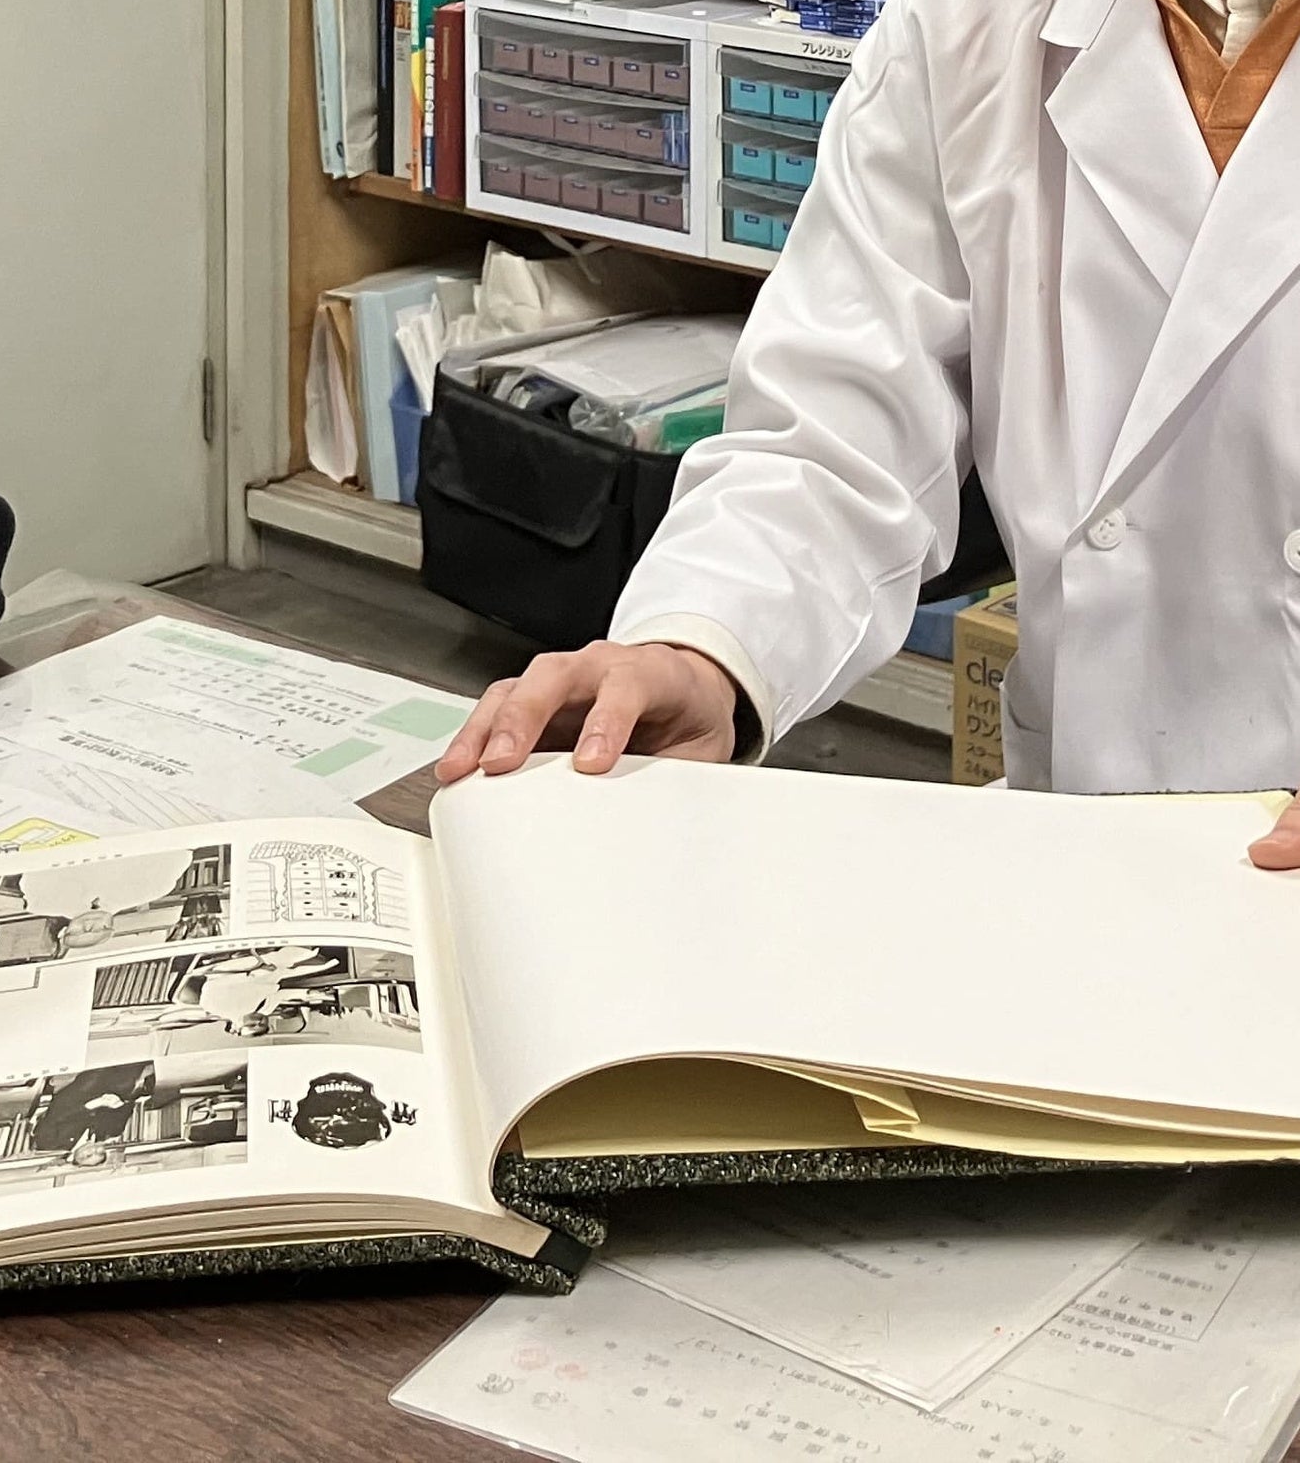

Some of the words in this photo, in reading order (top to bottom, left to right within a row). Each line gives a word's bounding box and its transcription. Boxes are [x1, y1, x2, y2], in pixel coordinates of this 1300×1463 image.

[801, 43, 852, 60] プレシジョン
[966, 657, 1003, 688] cle
